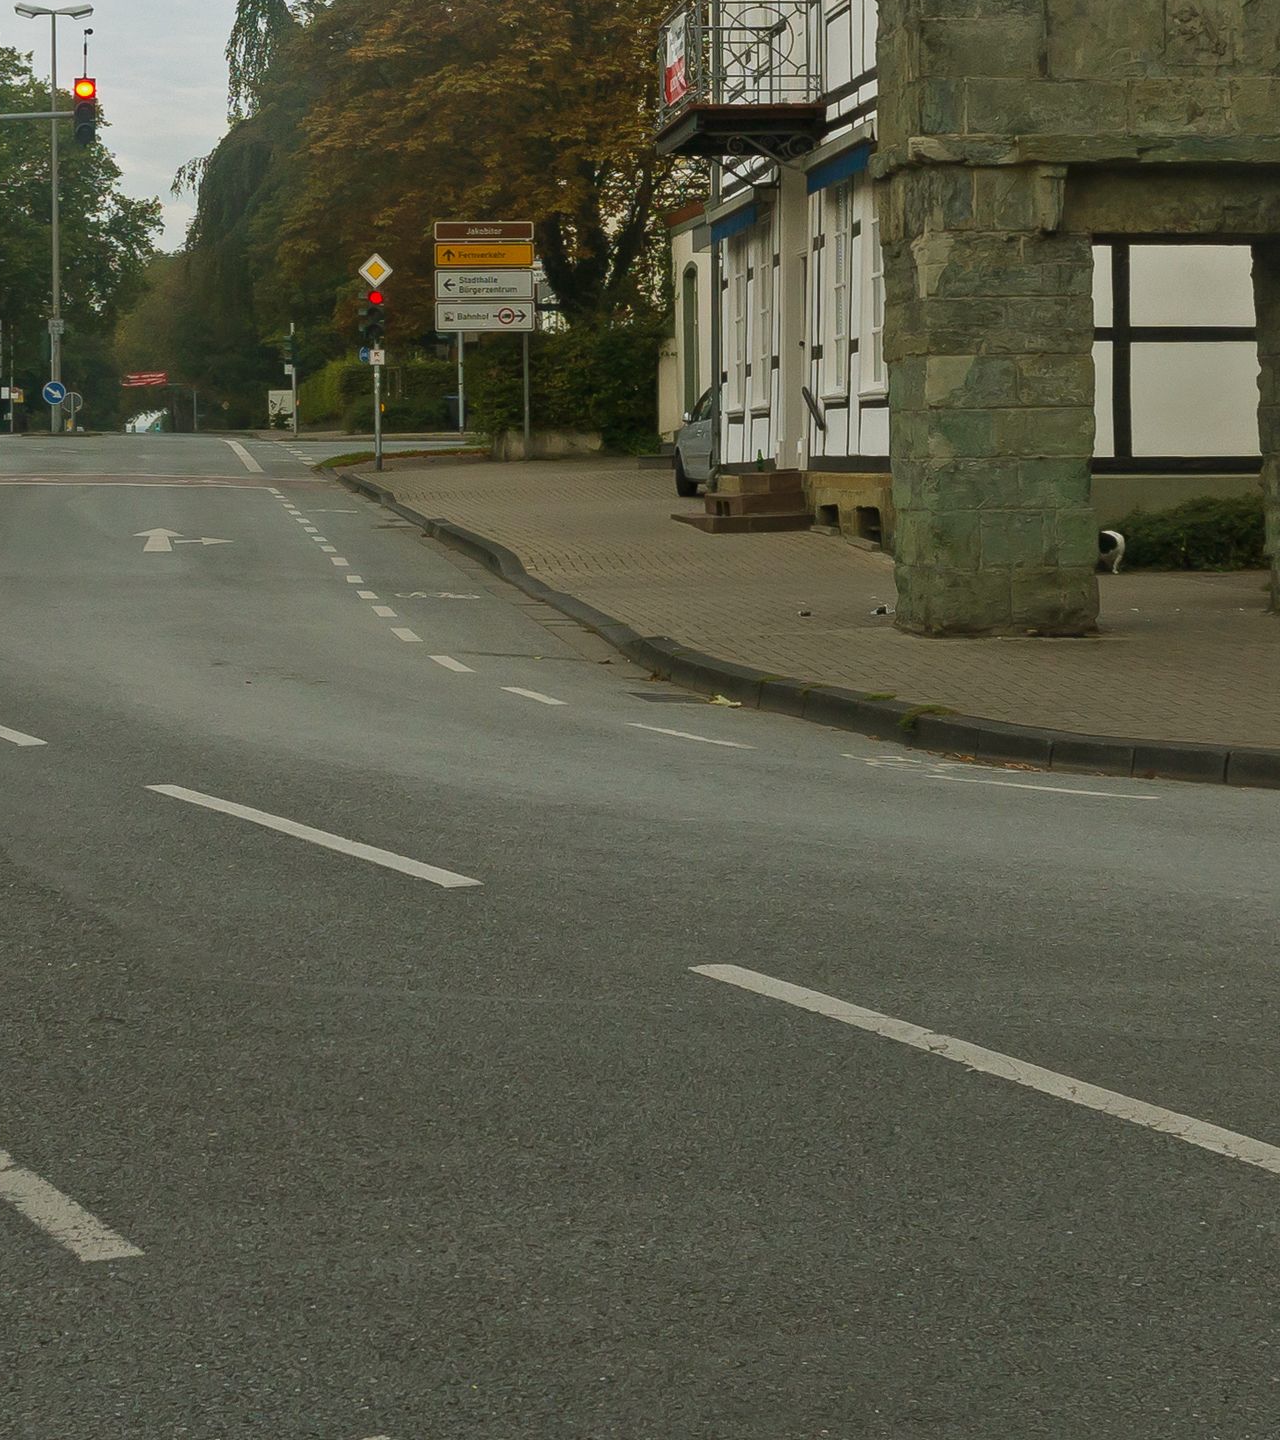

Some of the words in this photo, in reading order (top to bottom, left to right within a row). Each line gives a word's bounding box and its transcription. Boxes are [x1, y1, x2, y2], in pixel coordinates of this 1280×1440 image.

[466, 227, 502, 235] Jakobitor
[459, 276, 498, 284] Stadthalle
[459, 286, 518, 295] Bürgerzentrum
